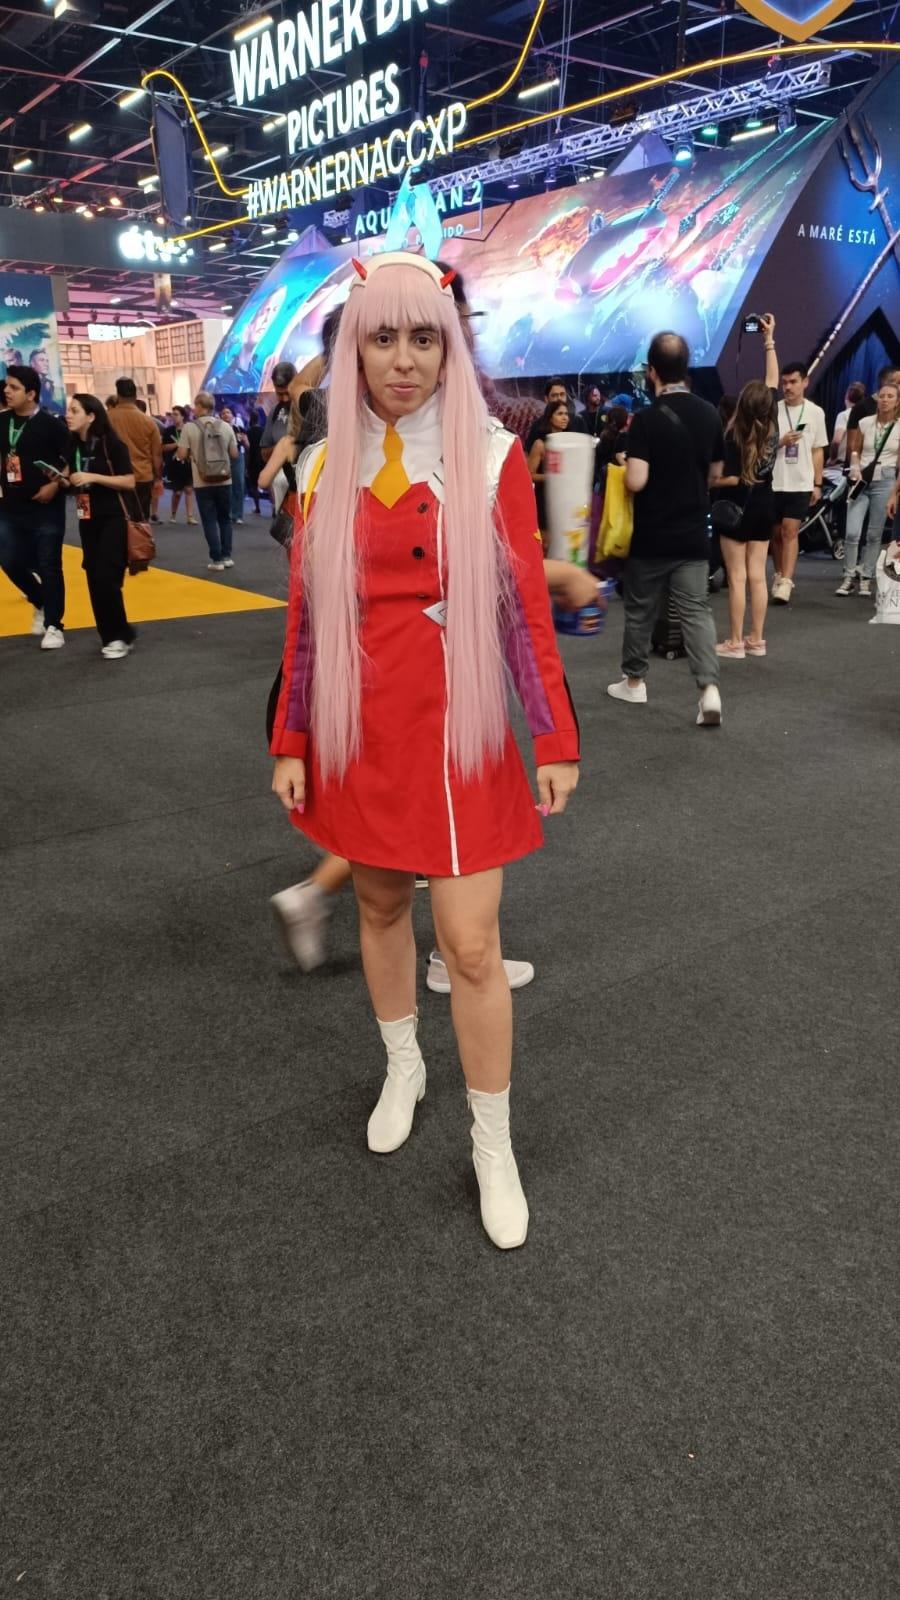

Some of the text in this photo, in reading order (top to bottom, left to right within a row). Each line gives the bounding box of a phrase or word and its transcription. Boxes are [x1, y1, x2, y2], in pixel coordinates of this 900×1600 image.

[229, 0, 367, 107] WARNER
[286, 62, 401, 155] PICTURES
[246, 102, 467, 219] #WARNERNACCXP
[354, 180, 482, 236] AQUAN 2
[797, 223, 876, 245] A MARÉ ESTÁ
